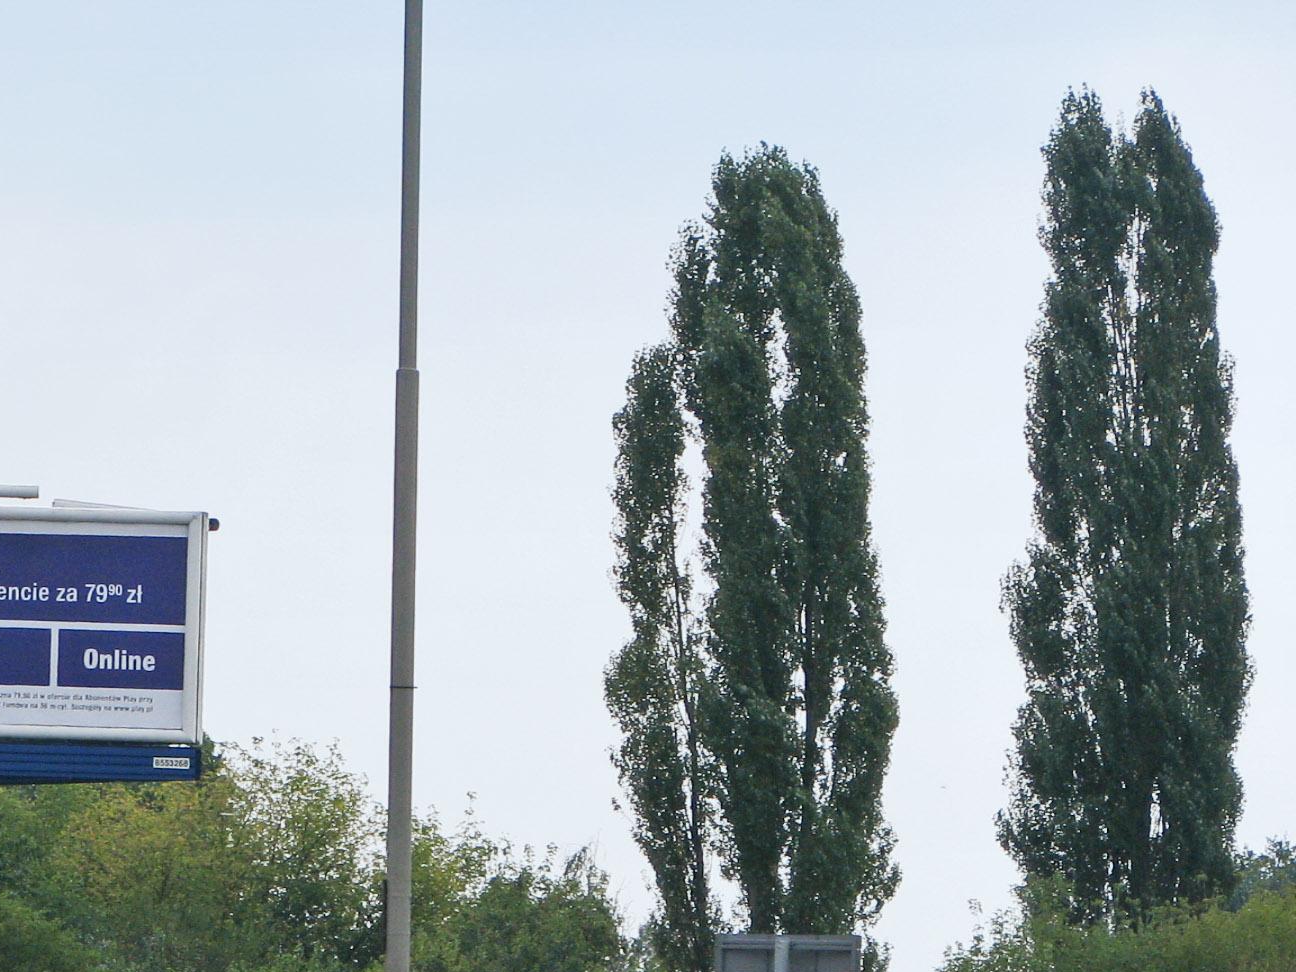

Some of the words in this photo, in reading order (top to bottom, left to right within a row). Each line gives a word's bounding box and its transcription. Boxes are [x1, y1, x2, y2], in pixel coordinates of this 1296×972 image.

[55, 586, 78, 602] za
[126, 584, 143, 603] zł
[83, 648, 156, 672] Online
